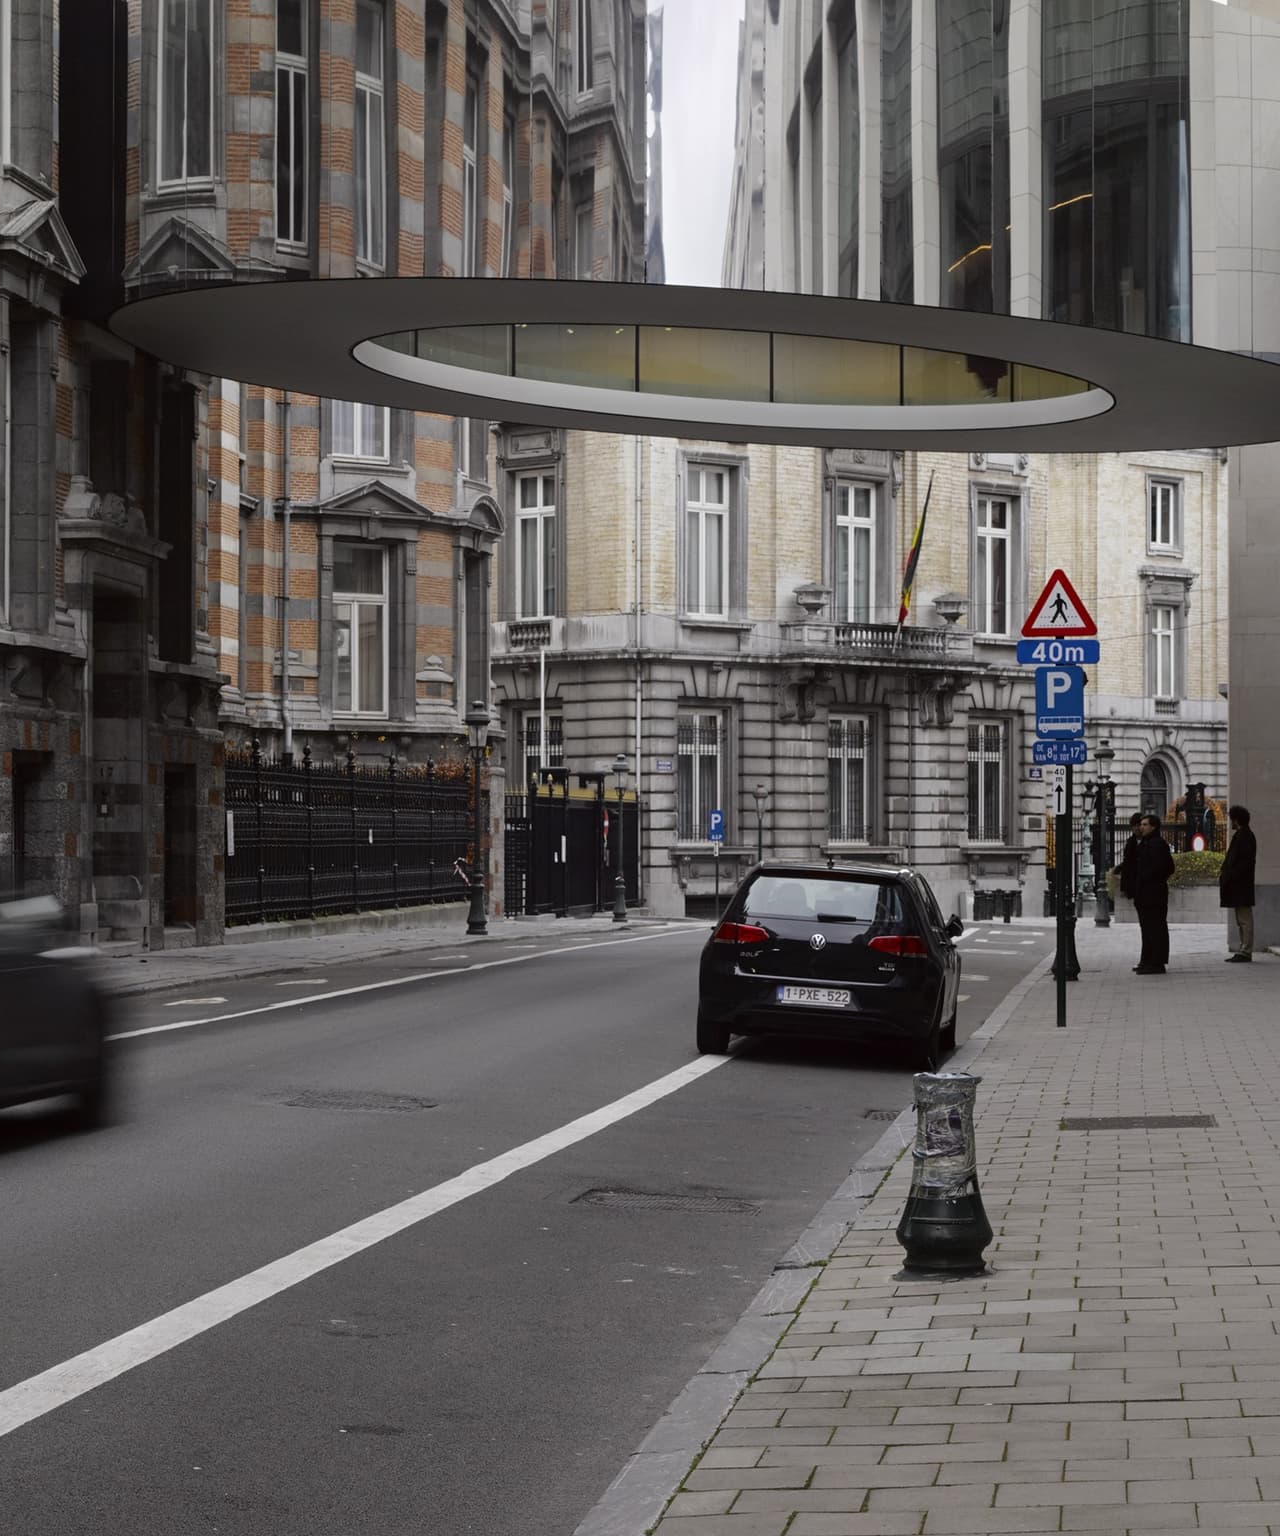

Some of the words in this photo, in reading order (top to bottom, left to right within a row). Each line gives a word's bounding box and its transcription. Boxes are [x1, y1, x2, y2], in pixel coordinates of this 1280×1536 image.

[1031, 642, 1085, 662] 40m
[1046, 671, 1072, 709] P
[1035, 753, 1047, 761] VAN
[1047, 747, 1053, 759] 8
[1070, 747, 1080, 759] 17
[1054, 768, 1065, 776] 40
[711, 813, 721, 830] P
